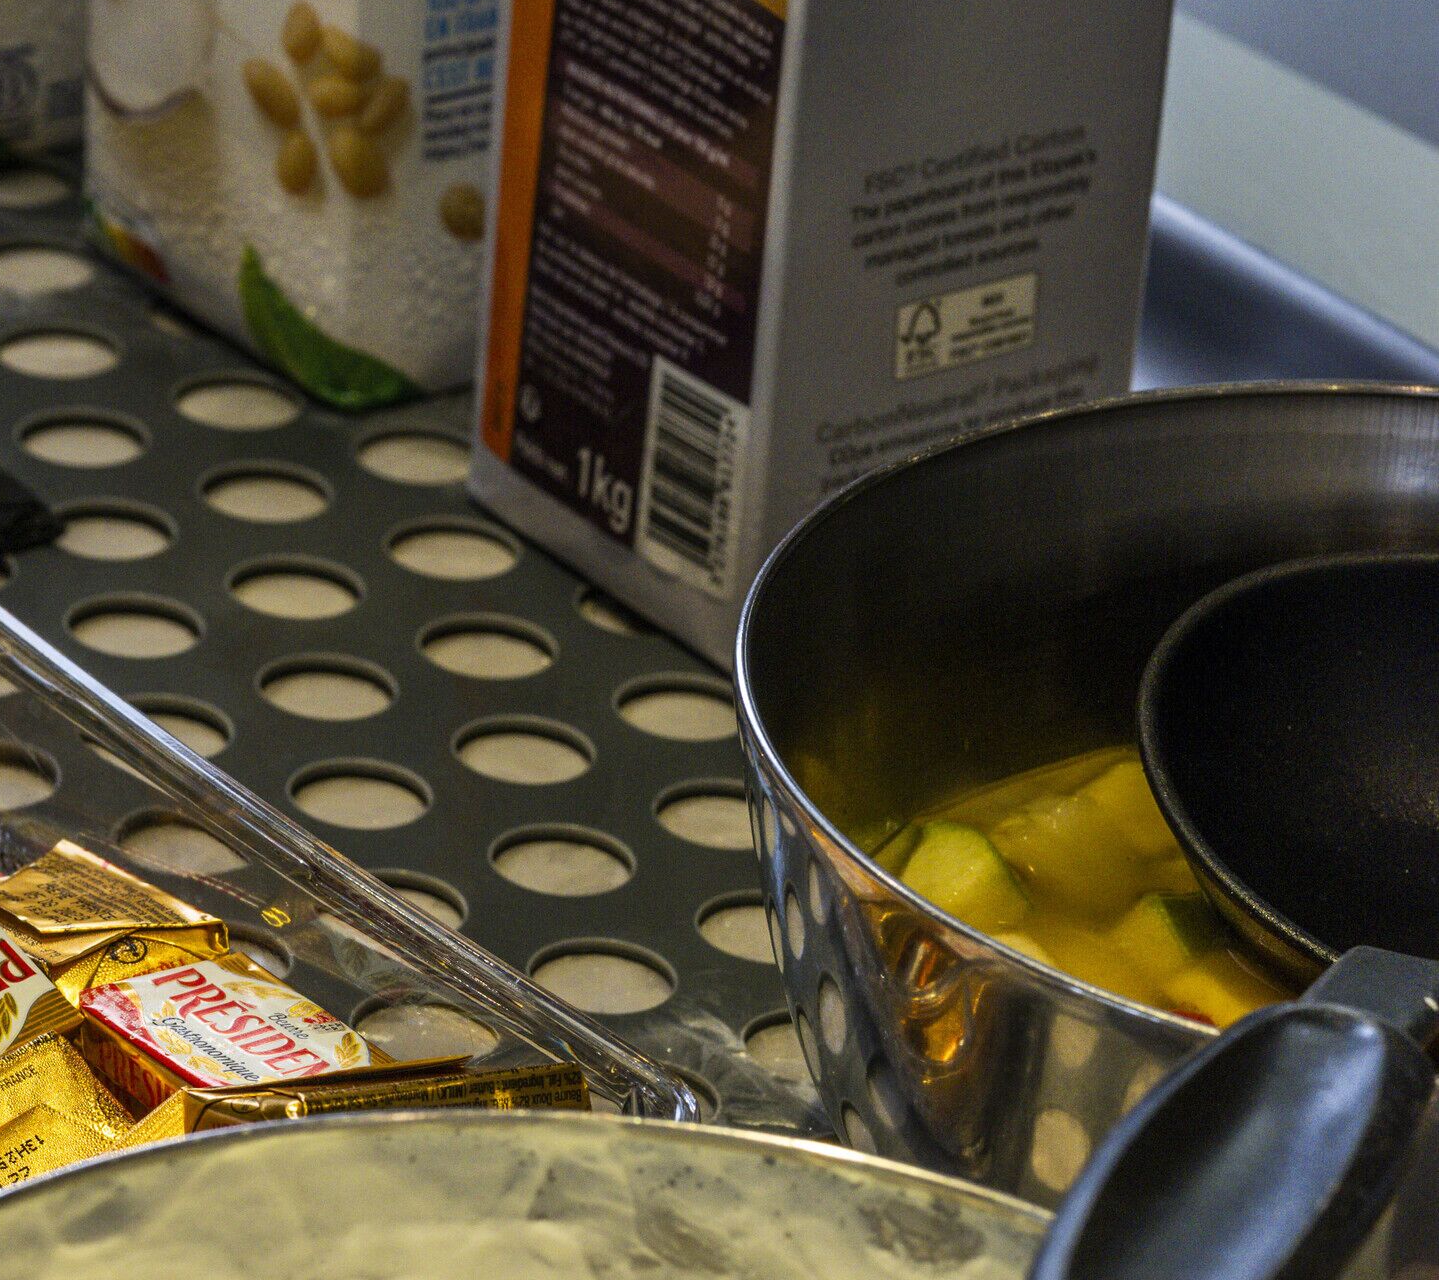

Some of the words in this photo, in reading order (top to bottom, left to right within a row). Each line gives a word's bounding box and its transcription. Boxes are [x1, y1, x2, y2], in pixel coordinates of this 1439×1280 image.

[576, 446, 633, 535] 1kg
[152, 966, 332, 1078] PRÉSIDEN
[161, 1015, 262, 1083] Gastronomique
[268, 1011, 309, 1041] Beurre
